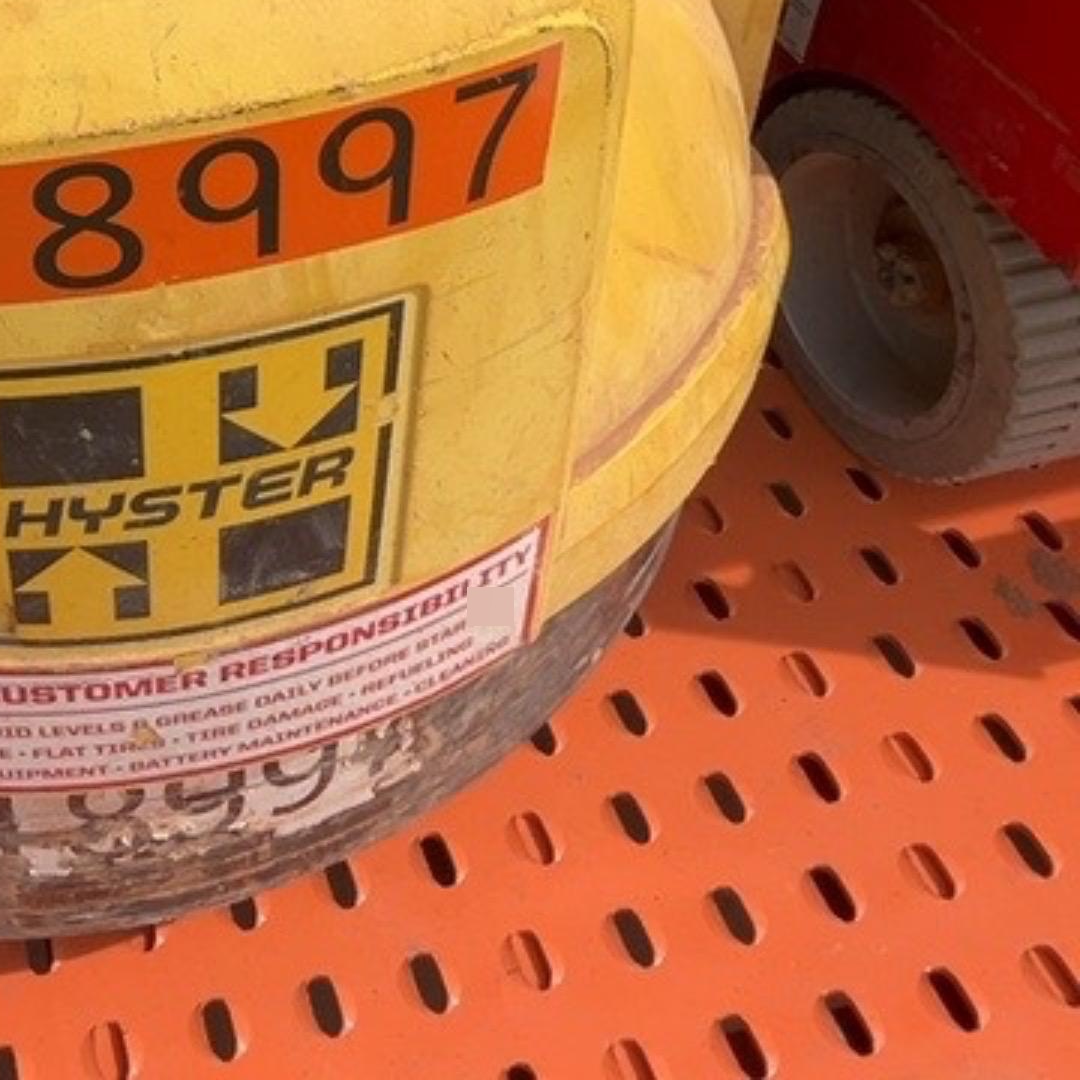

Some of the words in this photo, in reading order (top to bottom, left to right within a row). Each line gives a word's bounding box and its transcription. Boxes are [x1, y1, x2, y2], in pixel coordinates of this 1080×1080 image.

[5, 445, 356, 538] HYSTER
[31, 745, 86, 760] FLAT
[185, 720, 242, 745] TIRE
[247, 692, 344, 731] DAMAGE
[359, 635, 475, 697] REFUELING
[38, 721, 127, 740] LEVELS
[155, 699, 248, 728] GREASE
[254, 677, 322, 709] DAILY
[327, 647, 411, 688] BEFORE
[128, 745, 232, 773] BATTERY
[236, 692, 402, 754] MAINTENANCE
[413, 634, 511, 695] CLEANING
